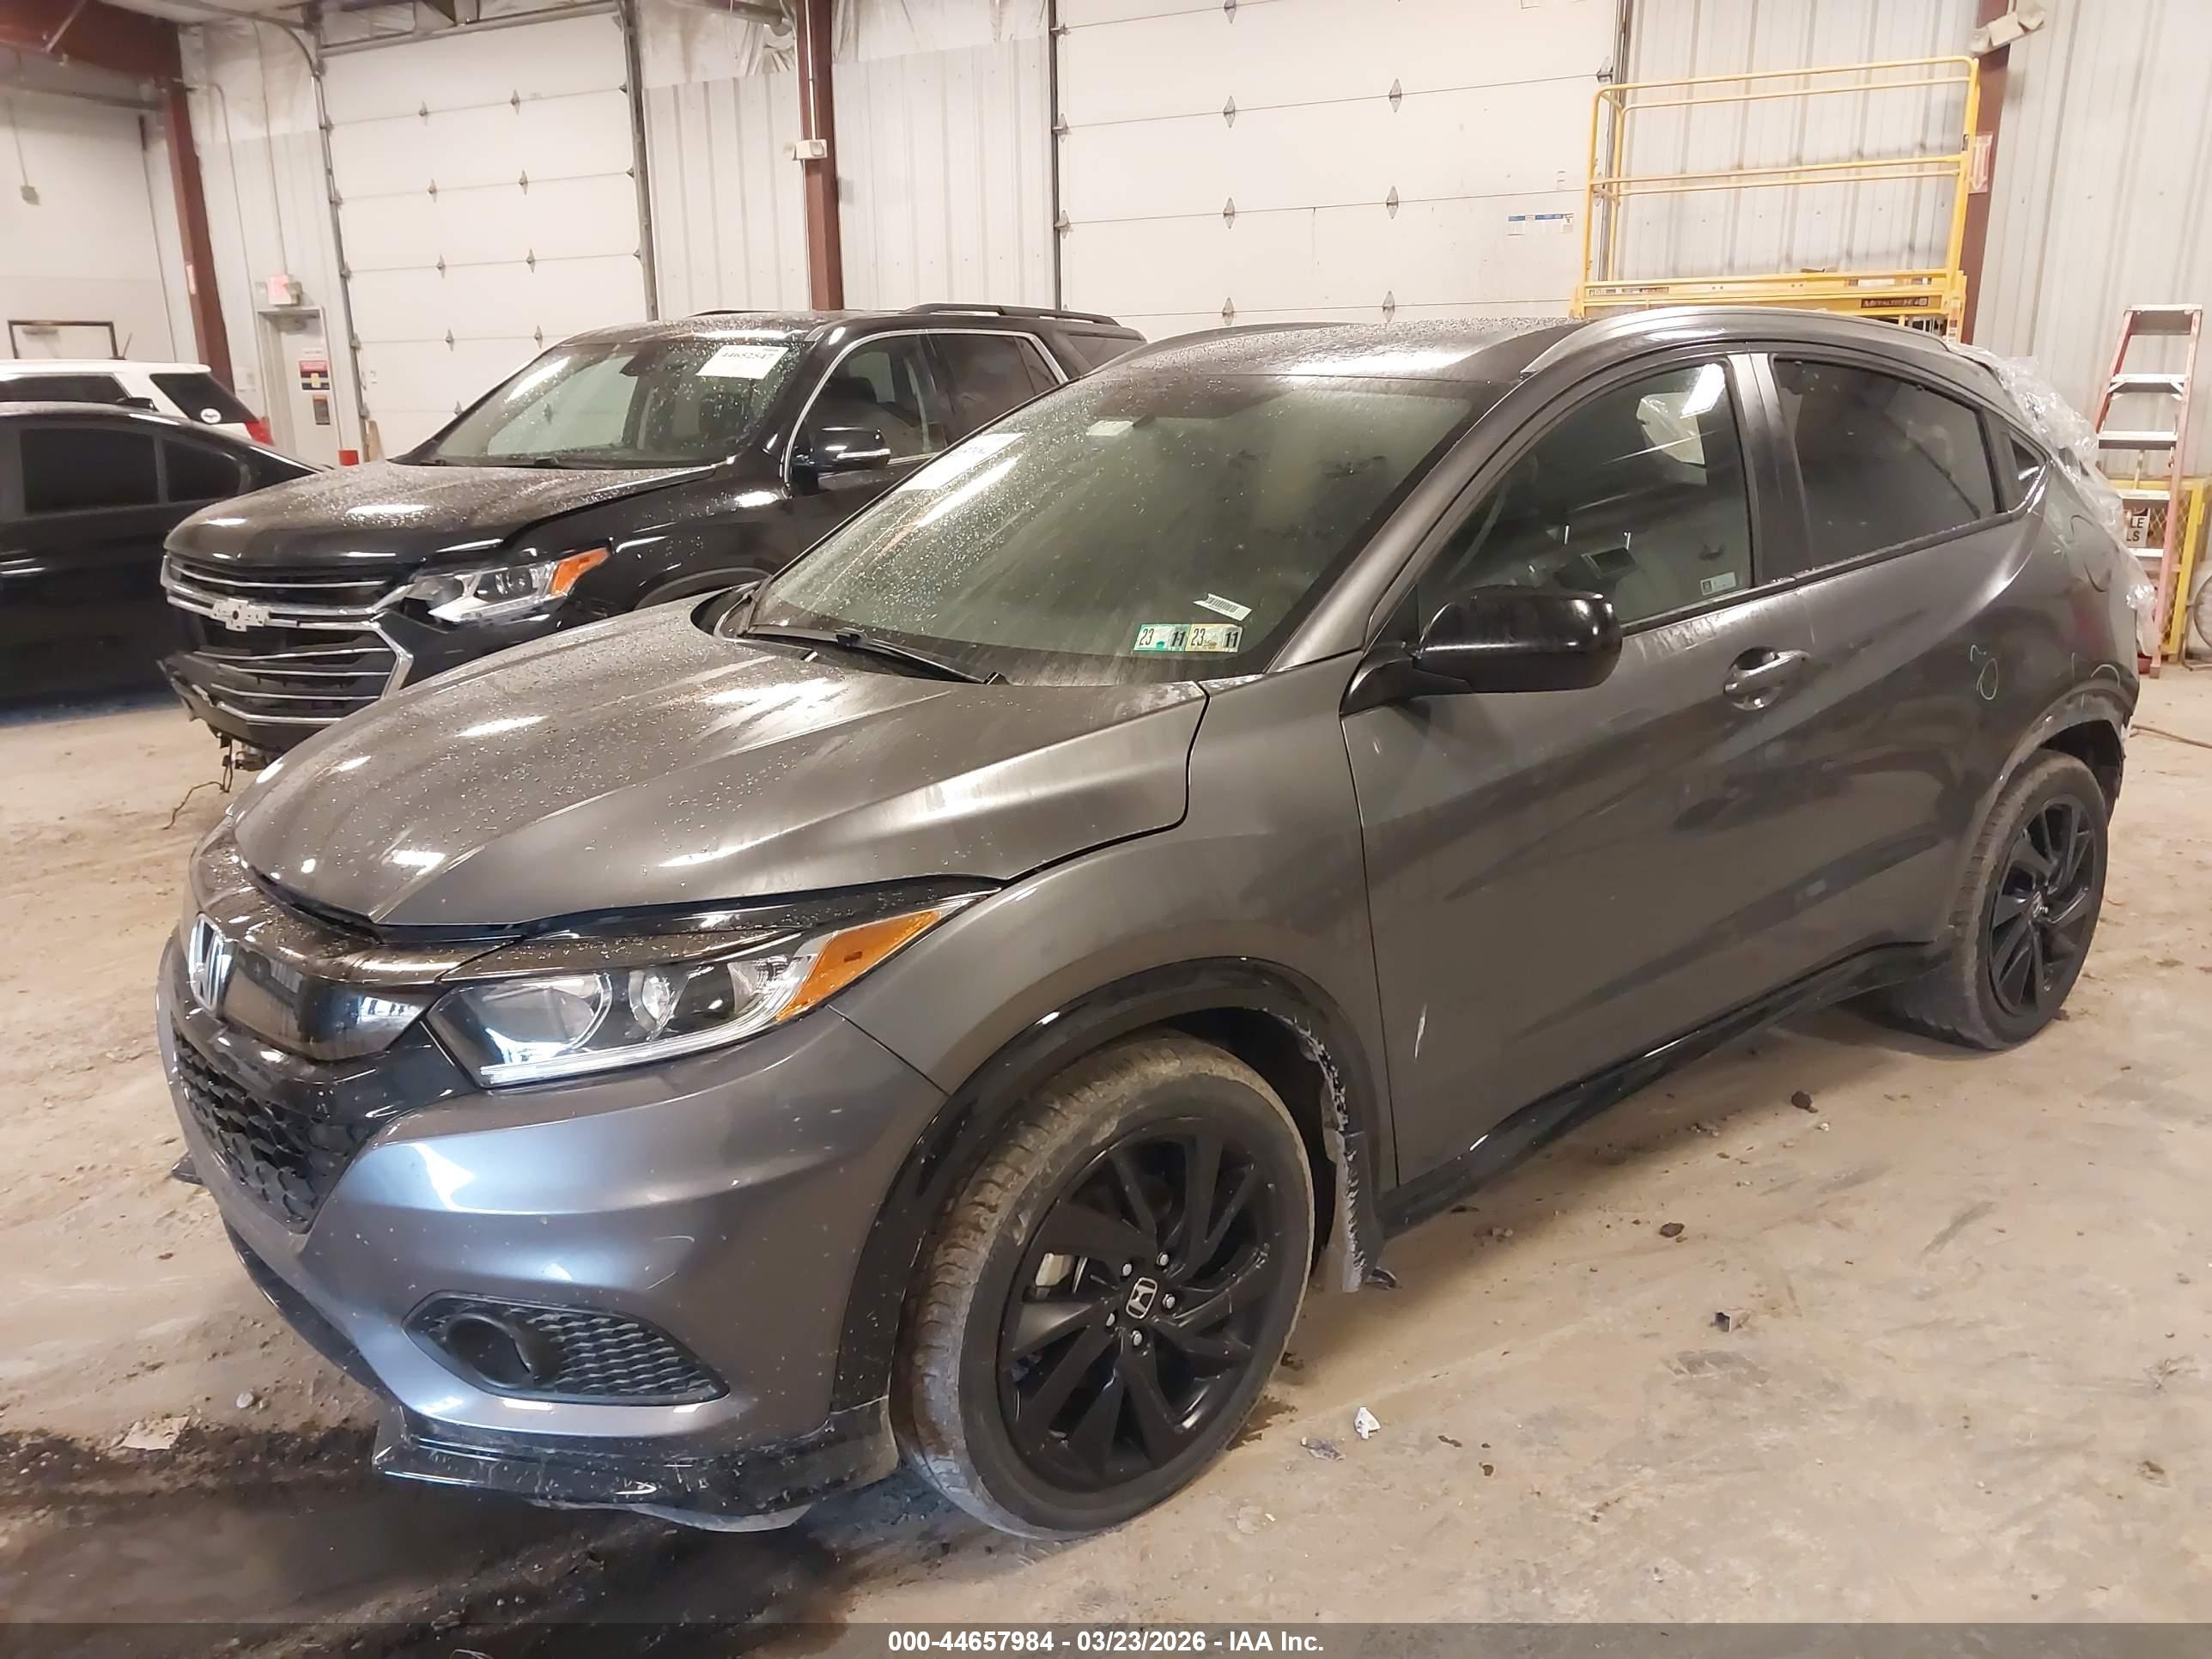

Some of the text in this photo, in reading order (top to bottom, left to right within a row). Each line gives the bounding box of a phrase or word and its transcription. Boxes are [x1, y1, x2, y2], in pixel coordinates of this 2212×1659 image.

[1139, 628, 1186, 647] 23 11
[1190, 628, 1238, 648] 23 11
